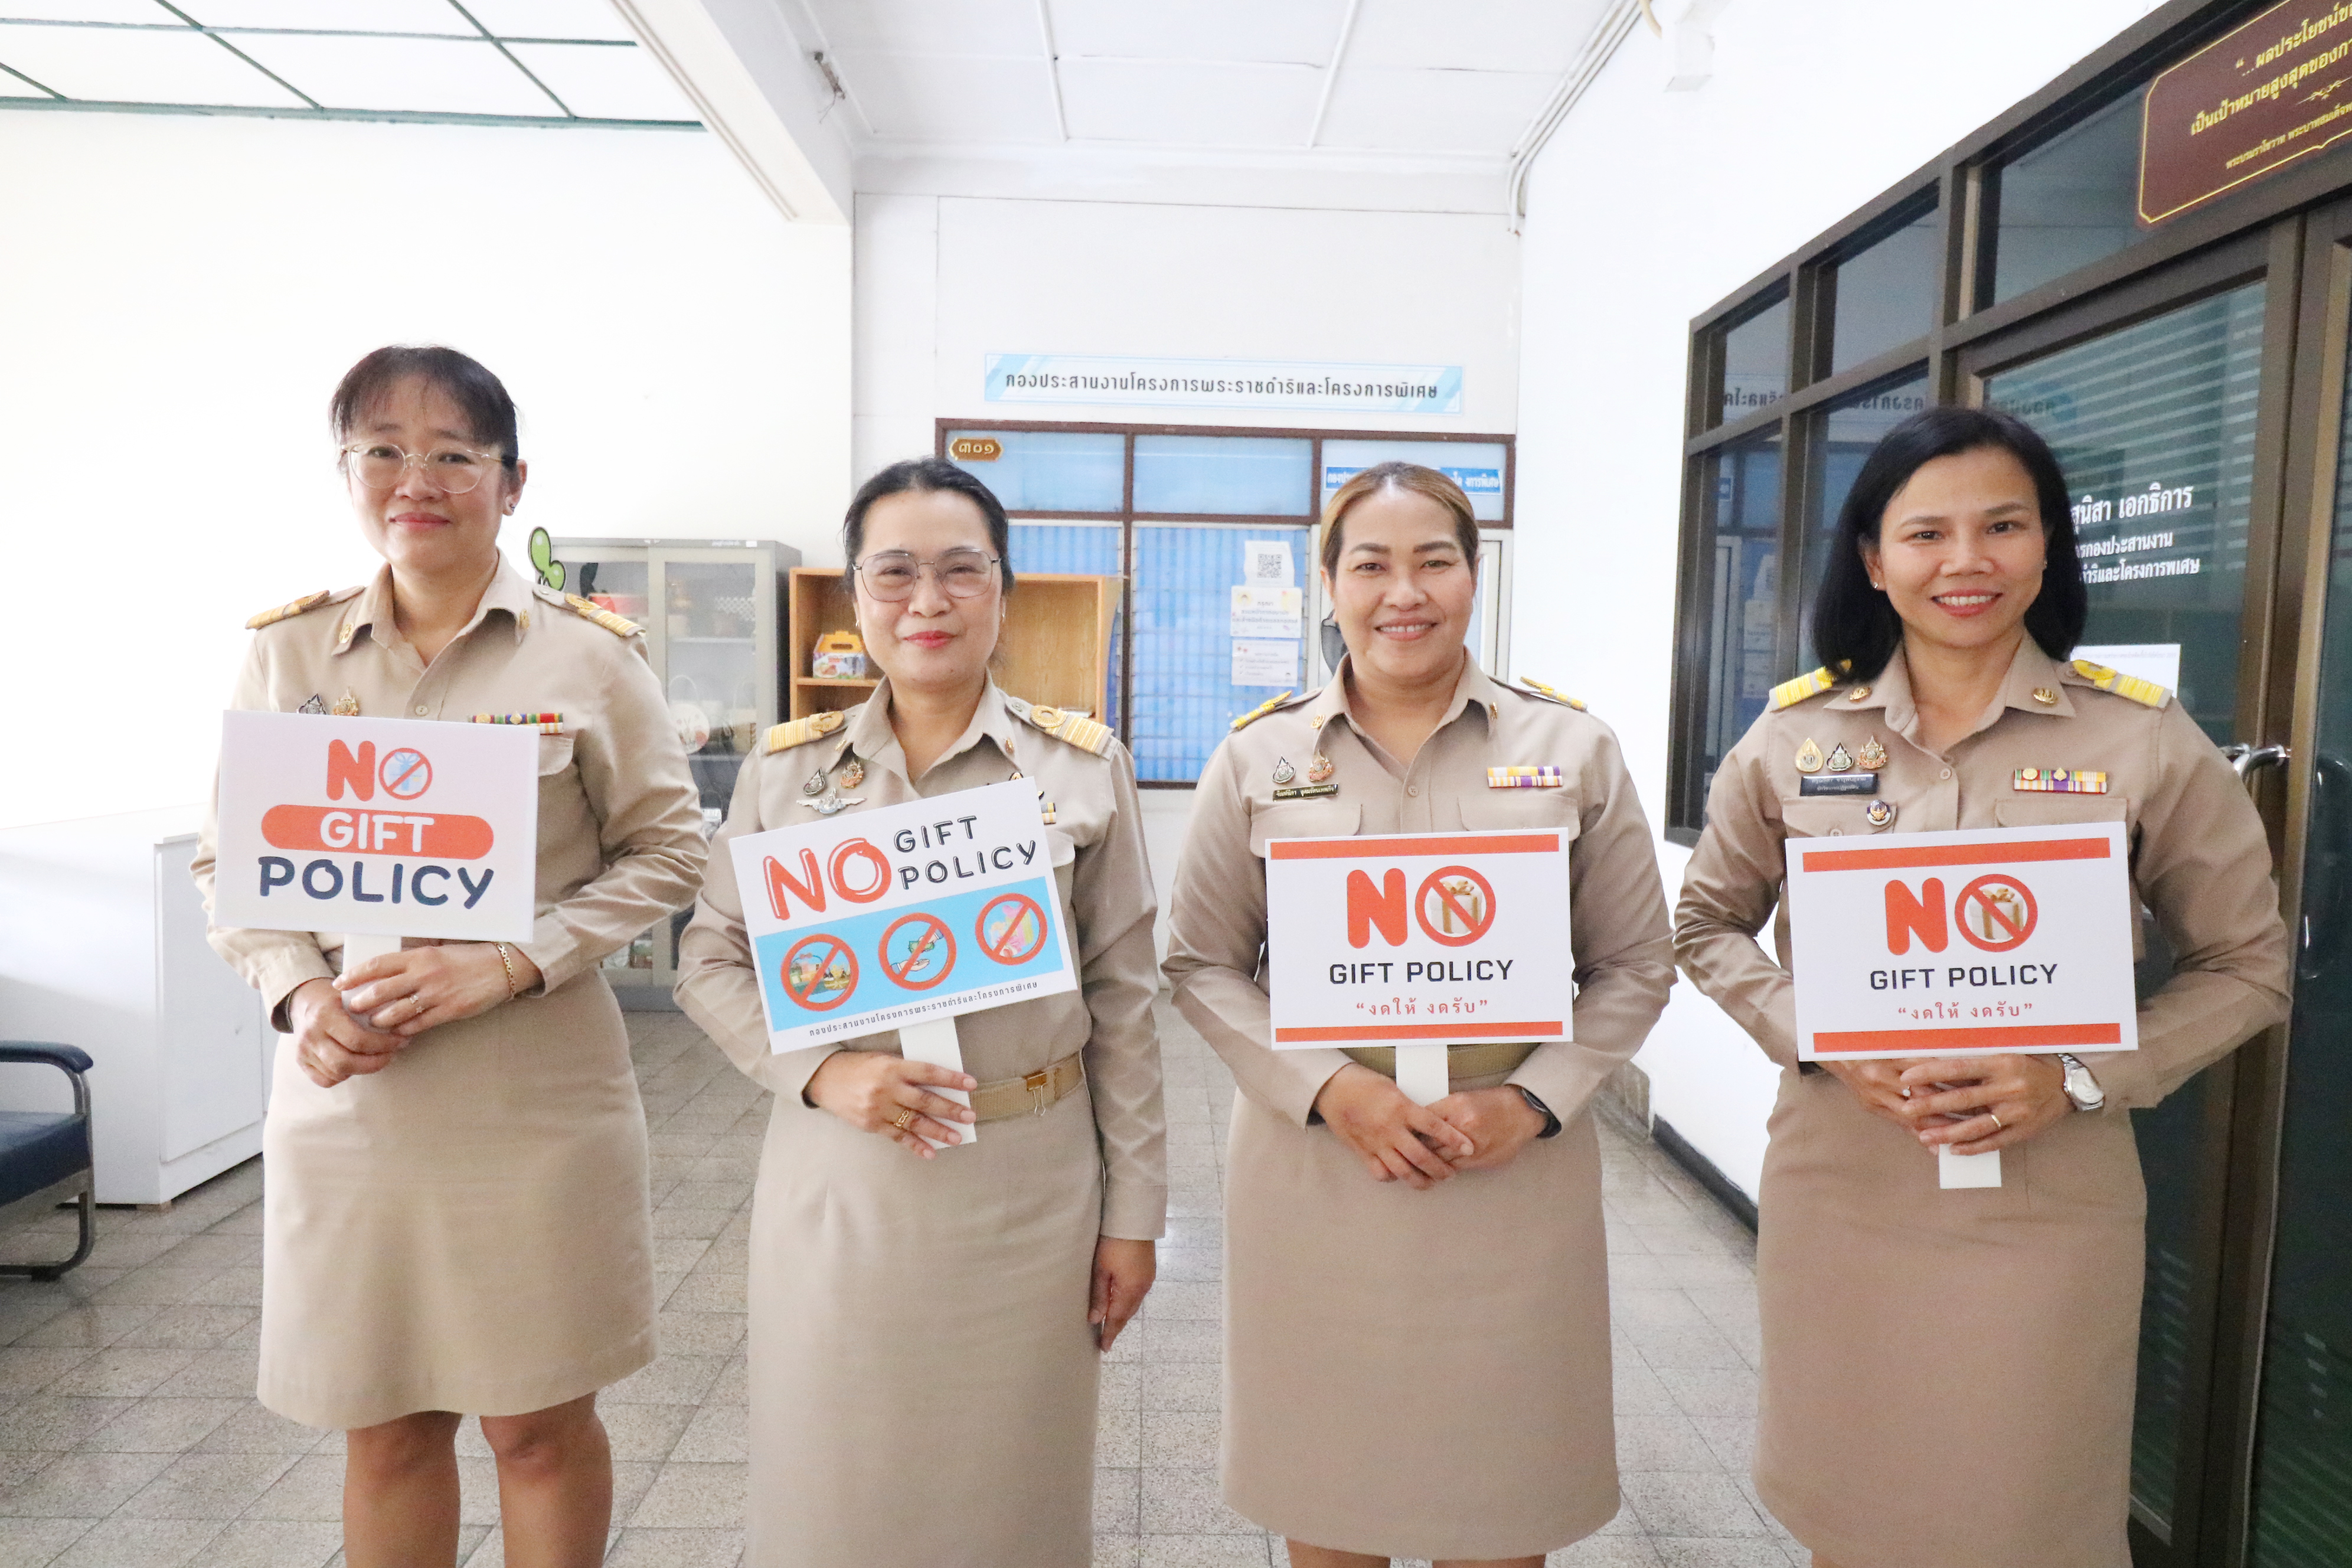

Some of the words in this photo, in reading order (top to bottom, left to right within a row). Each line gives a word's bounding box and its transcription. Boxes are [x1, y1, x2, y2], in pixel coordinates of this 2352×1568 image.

[1006, 372, 1438, 398] กองประสานงานโครงการพระราชดำริและโครงการพิเศษ
[958, 442, 995, 455] ๓๐๑
[2118, 481, 2194, 518] เอกธิการ
[320, 811, 435, 852] GIFT
[894, 815, 976, 853] GIFT
[258, 856, 494, 910] POLICY
[763, 837, 891, 920] NO
[898, 840, 1036, 890] POLICY
[1329, 963, 1393, 984] GIFT
[1407, 959, 1513, 982] POLICY
[1870, 969, 1935, 990] GIFT
[1949, 963, 2058, 988] POLICY
[809, 981, 1038, 1036] กองประสานงานโครงการพระราชดำริและโครงการพิเศษ
